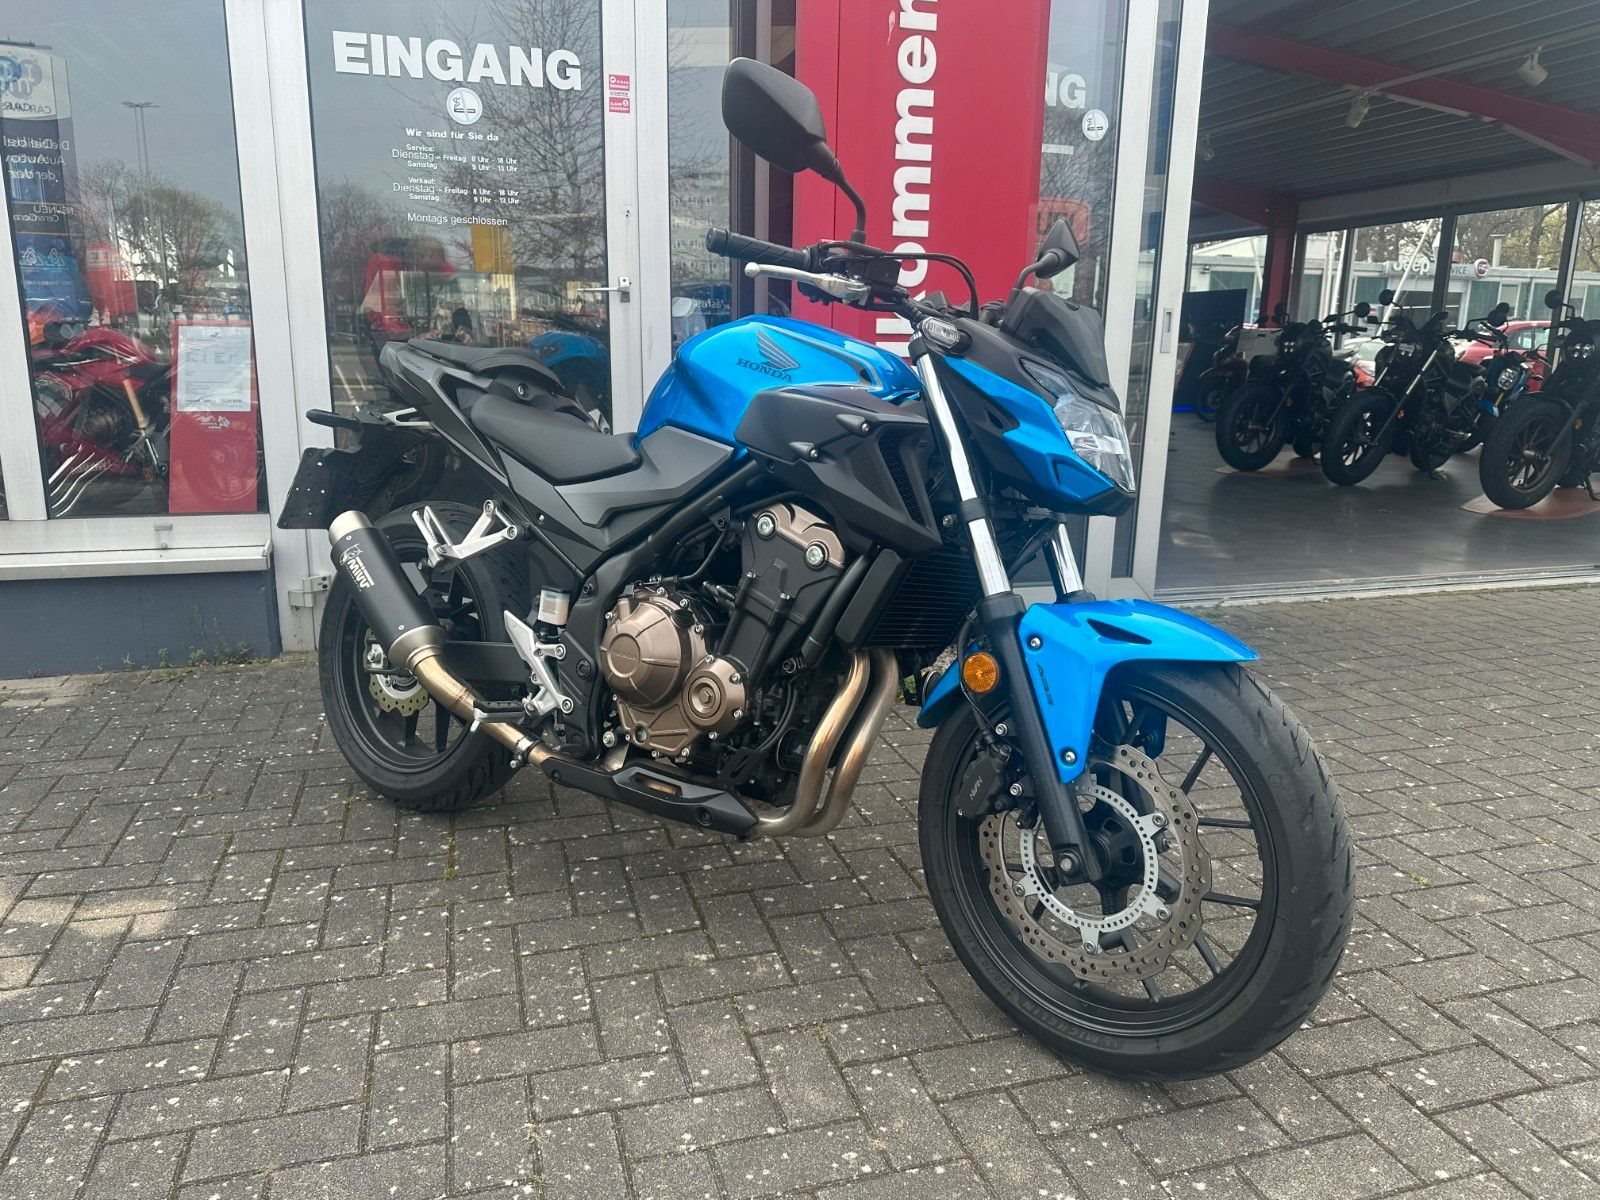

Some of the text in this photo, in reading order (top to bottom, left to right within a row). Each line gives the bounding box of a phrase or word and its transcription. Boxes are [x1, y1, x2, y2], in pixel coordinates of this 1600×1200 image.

[332, 30, 582, 91] EINGANG
[405, 127, 499, 142] Wir sind für Sie da
[406, 143, 435, 152] Service:
[391, 148, 434, 163] Dienstag
[442, 154, 467, 164] Freitag
[471, 155, 477, 163] 8
[477, 155, 490, 164] Uhr
[497, 156, 504, 164] 18
[505, 157, 518, 165] Uhr
[407, 160, 438, 170] Samstag
[471, 163, 477, 171] 9
[478, 163, 491, 171] Uhr
[498, 164, 505, 172] 13
[506, 165, 518, 173] Uhr
[408, 176, 436, 185] Verkauf:
[392, 182, 435, 195] Dienstag
[444, 186, 468, 196] Freitag
[479, 188, 491, 196] Uhr
[507, 189, 519, 197] Uhr
[409, 192, 440, 202] Samstag
[507, 197, 520, 205] Uhr
[407, 211, 508, 226] Montags geschlossen
[1392, 257, 1431, 275] Jeep
[1451, 265, 1468, 275] VICE
[736, 357, 793, 383] HONDA
